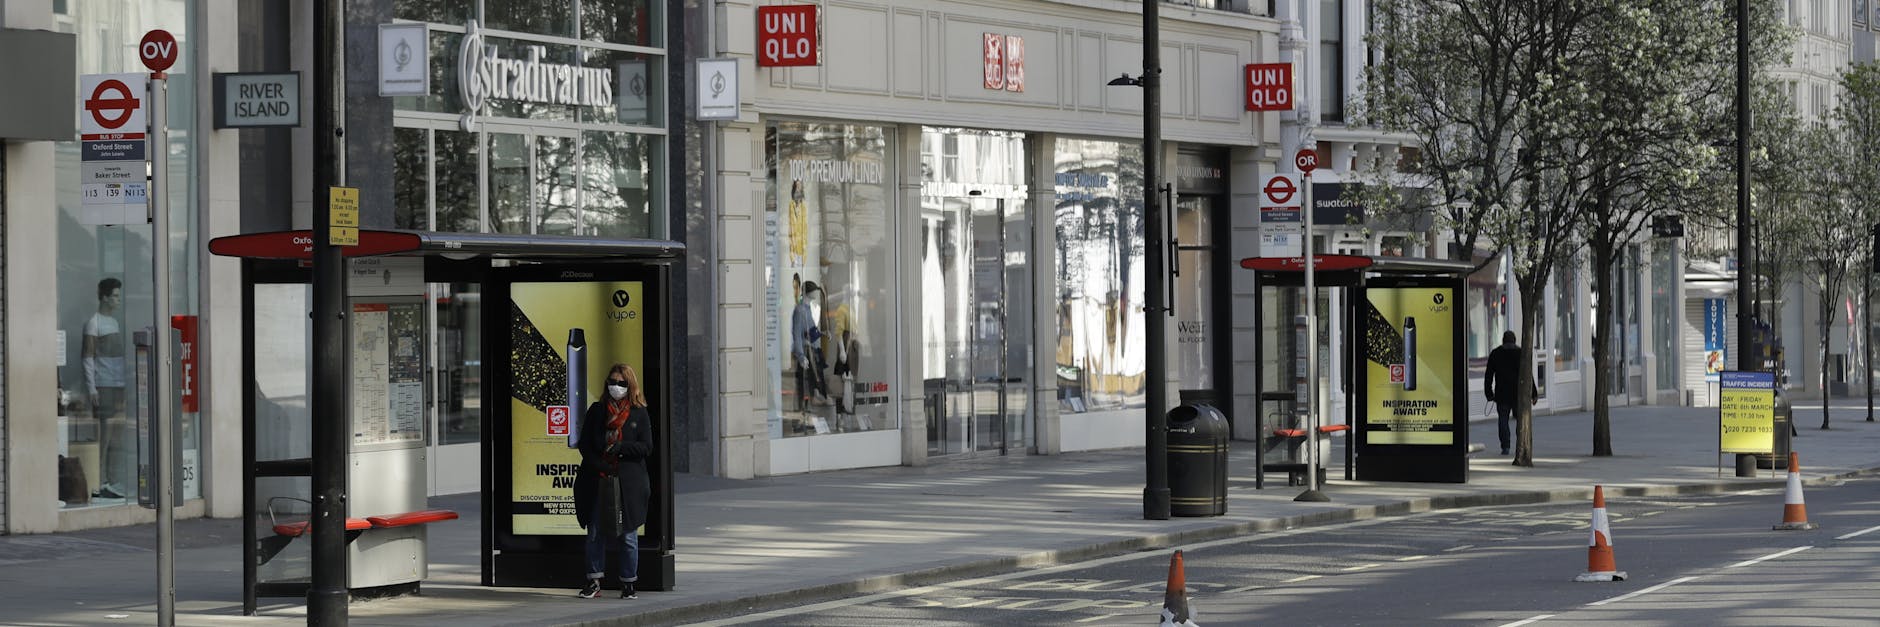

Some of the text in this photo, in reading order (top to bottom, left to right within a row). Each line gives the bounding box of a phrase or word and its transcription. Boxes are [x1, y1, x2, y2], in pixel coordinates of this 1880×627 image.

[765, 13, 806, 34] UNI
[143, 41, 173, 60] OV
[765, 38, 810, 62] QLO
[480, 45, 613, 107] stradivarius
[1251, 68, 1284, 86] UNI
[240, 83, 284, 99] RIVER
[1252, 88, 1287, 108] QLO
[234, 101, 290, 117] ISLAND
[92, 143, 113, 151] Oxford
[1298, 156, 1316, 166] OR
[810, 159, 853, 183] PREMIUM
[854, 160, 882, 184] LINEN
[85, 188, 146, 197] 113 139 N113
[293, 236, 313, 245] Oxfo
[606, 310, 636, 322] vype
[1382, 400, 1438, 408] INSPIRATION
[536, 464, 581, 476] INSPIR
[552, 477, 575, 488] AW
